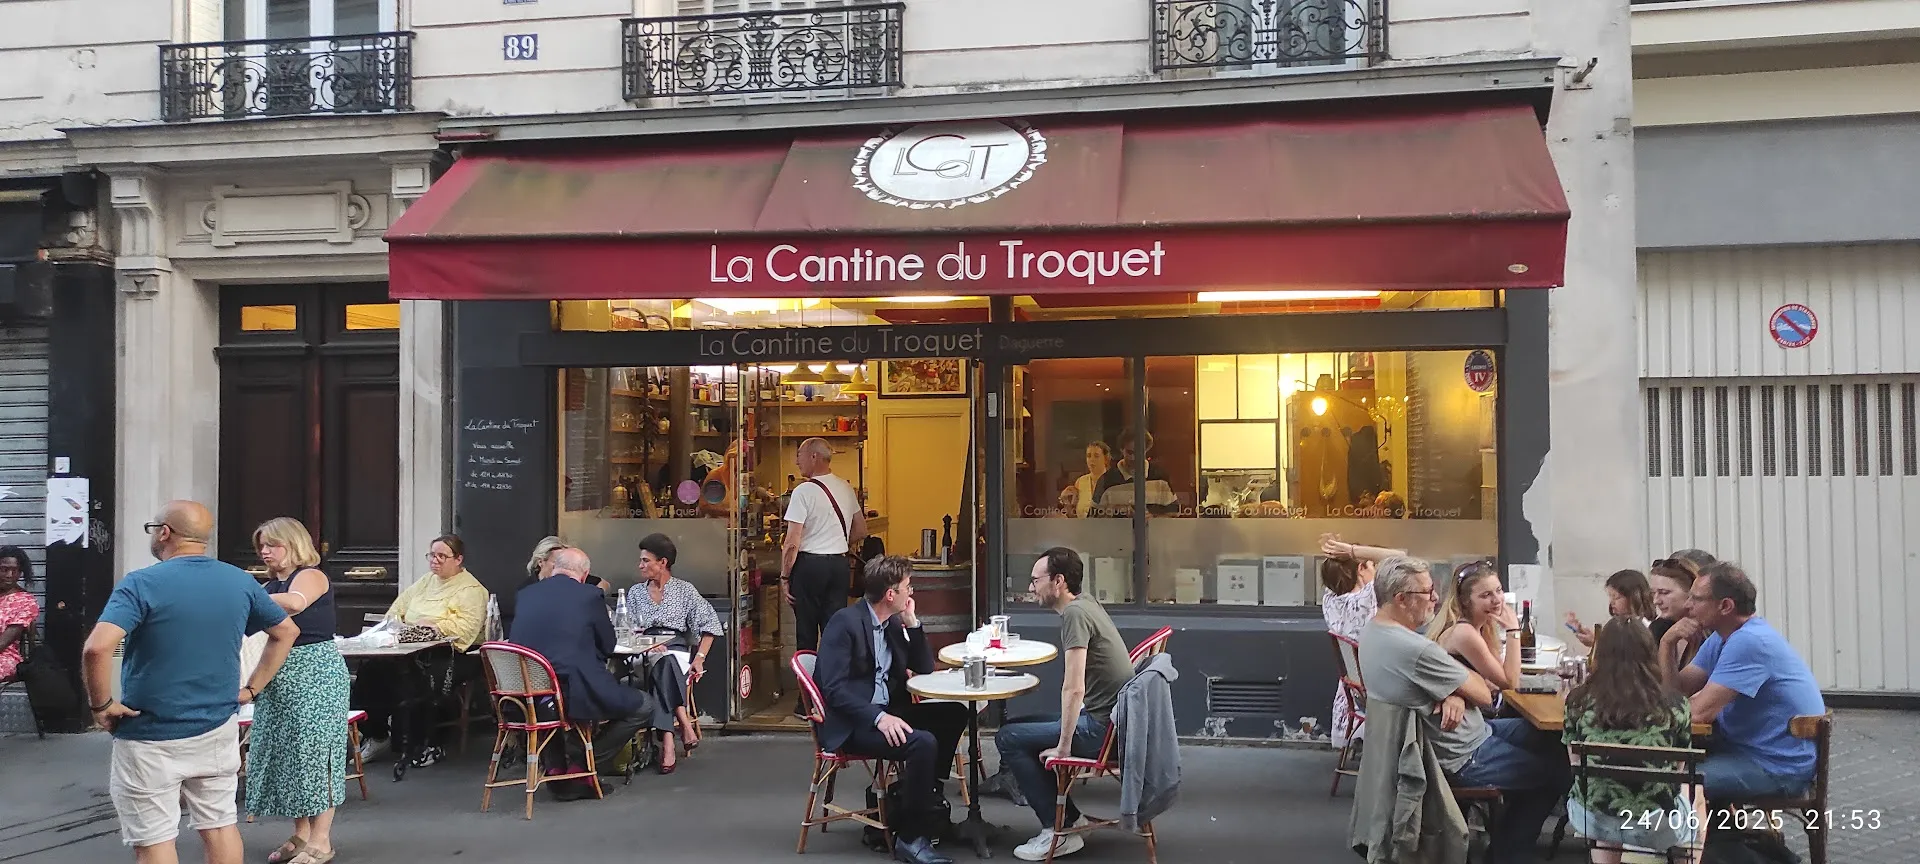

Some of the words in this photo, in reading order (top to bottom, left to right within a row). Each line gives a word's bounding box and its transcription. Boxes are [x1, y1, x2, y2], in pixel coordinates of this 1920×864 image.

[506, 36, 535, 59] 89
[710, 244, 753, 283] La
[765, 244, 925, 283] Cantine
[936, 241, 987, 281] du
[999, 239, 1166, 285] Troquet
[700, 334, 724, 356] La
[731, 331, 833, 356] Cantine
[840, 330, 870, 354] du
[877, 327, 983, 357] Troquet
[999, 334, 1065, 353] Daguerre
[1474, 372, 1487, 383] IV
[464, 419, 477, 430] La
[477, 419, 500, 430] Cantine
[501, 420, 511, 429] du
[510, 418, 539, 434] Troquet
[660, 505, 700, 518] Trquet
[1024, 504, 1067, 517] Cantine
[1179, 504, 1193, 516] La
[1263, 504, 1308, 518] Troquet
[1326, 504, 1341, 517] La
[1343, 504, 1392, 518] Cantine
[1413, 504, 1462, 519] Troquet
